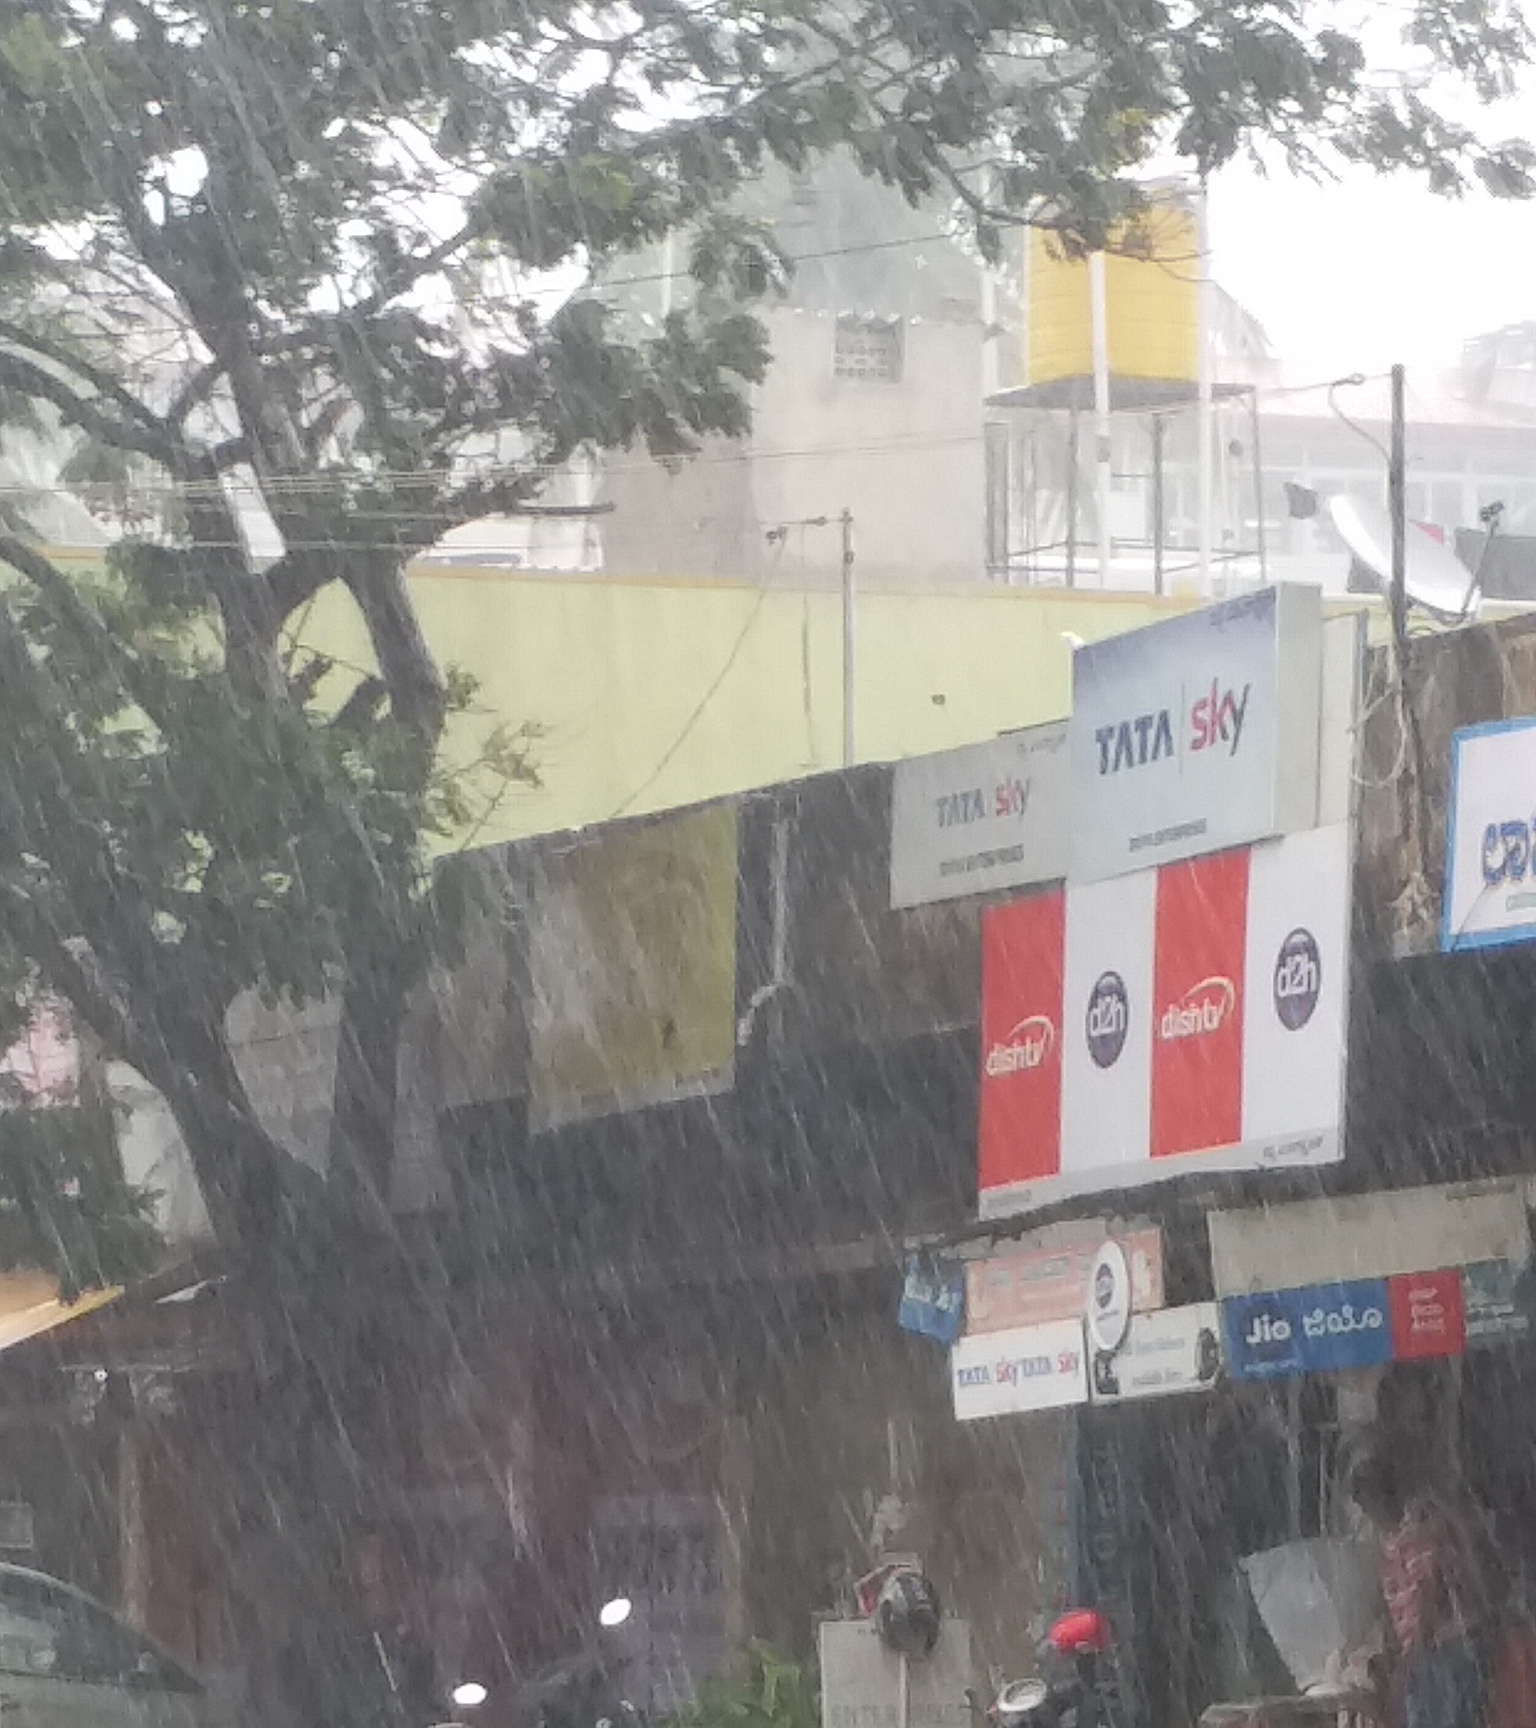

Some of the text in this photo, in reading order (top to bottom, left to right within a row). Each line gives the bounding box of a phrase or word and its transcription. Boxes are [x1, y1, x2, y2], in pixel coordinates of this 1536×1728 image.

[1095, 708, 1175, 775] TATA
[937, 787, 985, 828] TATA
[1277, 953, 1318, 999] d2h
[1245, 1313, 1292, 1344] Jio
